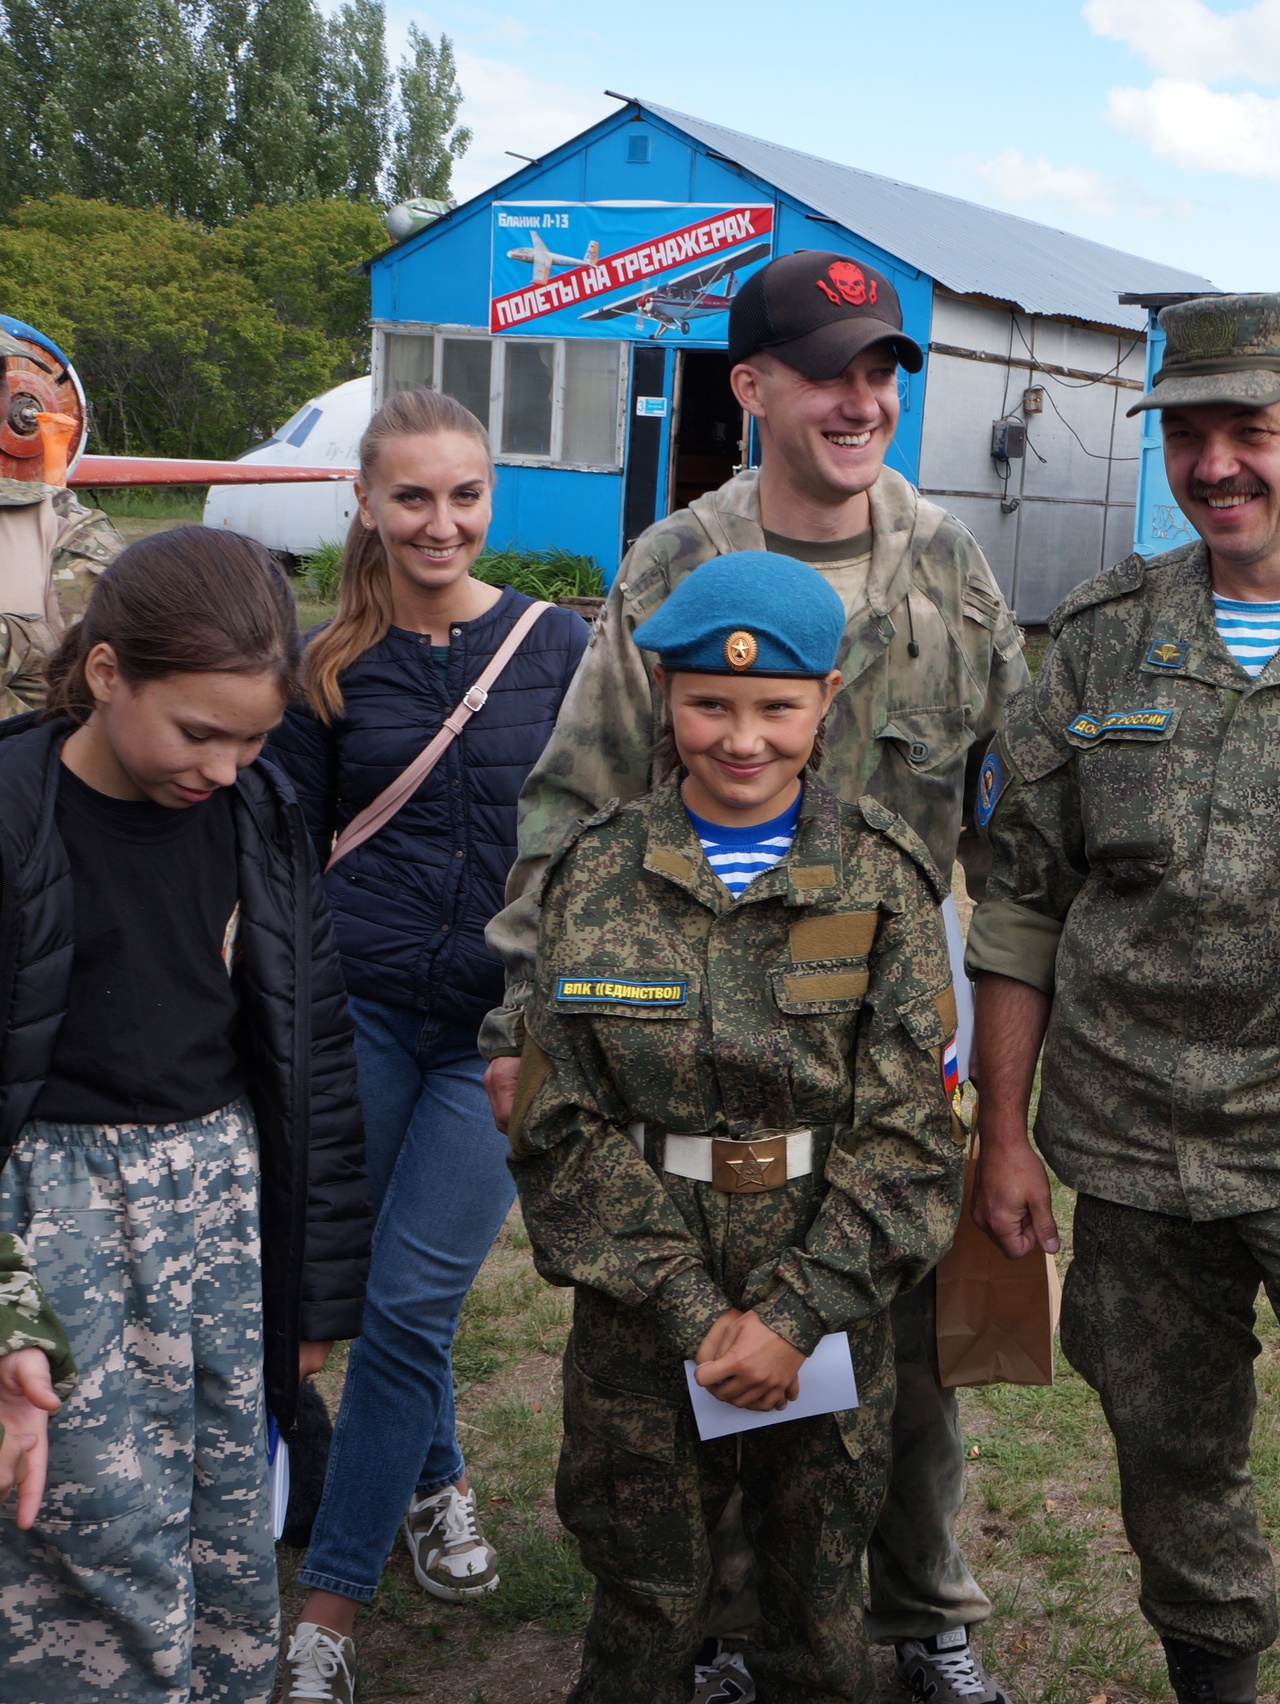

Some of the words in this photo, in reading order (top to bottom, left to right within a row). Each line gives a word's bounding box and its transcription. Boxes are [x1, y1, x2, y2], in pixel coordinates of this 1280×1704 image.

[542, 213, 569, 228] Л-13
[496, 276, 580, 326] ПОЛЕТЫ
[581, 265, 611, 295] НА
[612, 210, 756, 280] ТРЕНАЖЕРАХ
[638, 400, 645, 412] 3
[563, 983, 592, 995] ВПК
[942, 1633, 962, 1643] 574
